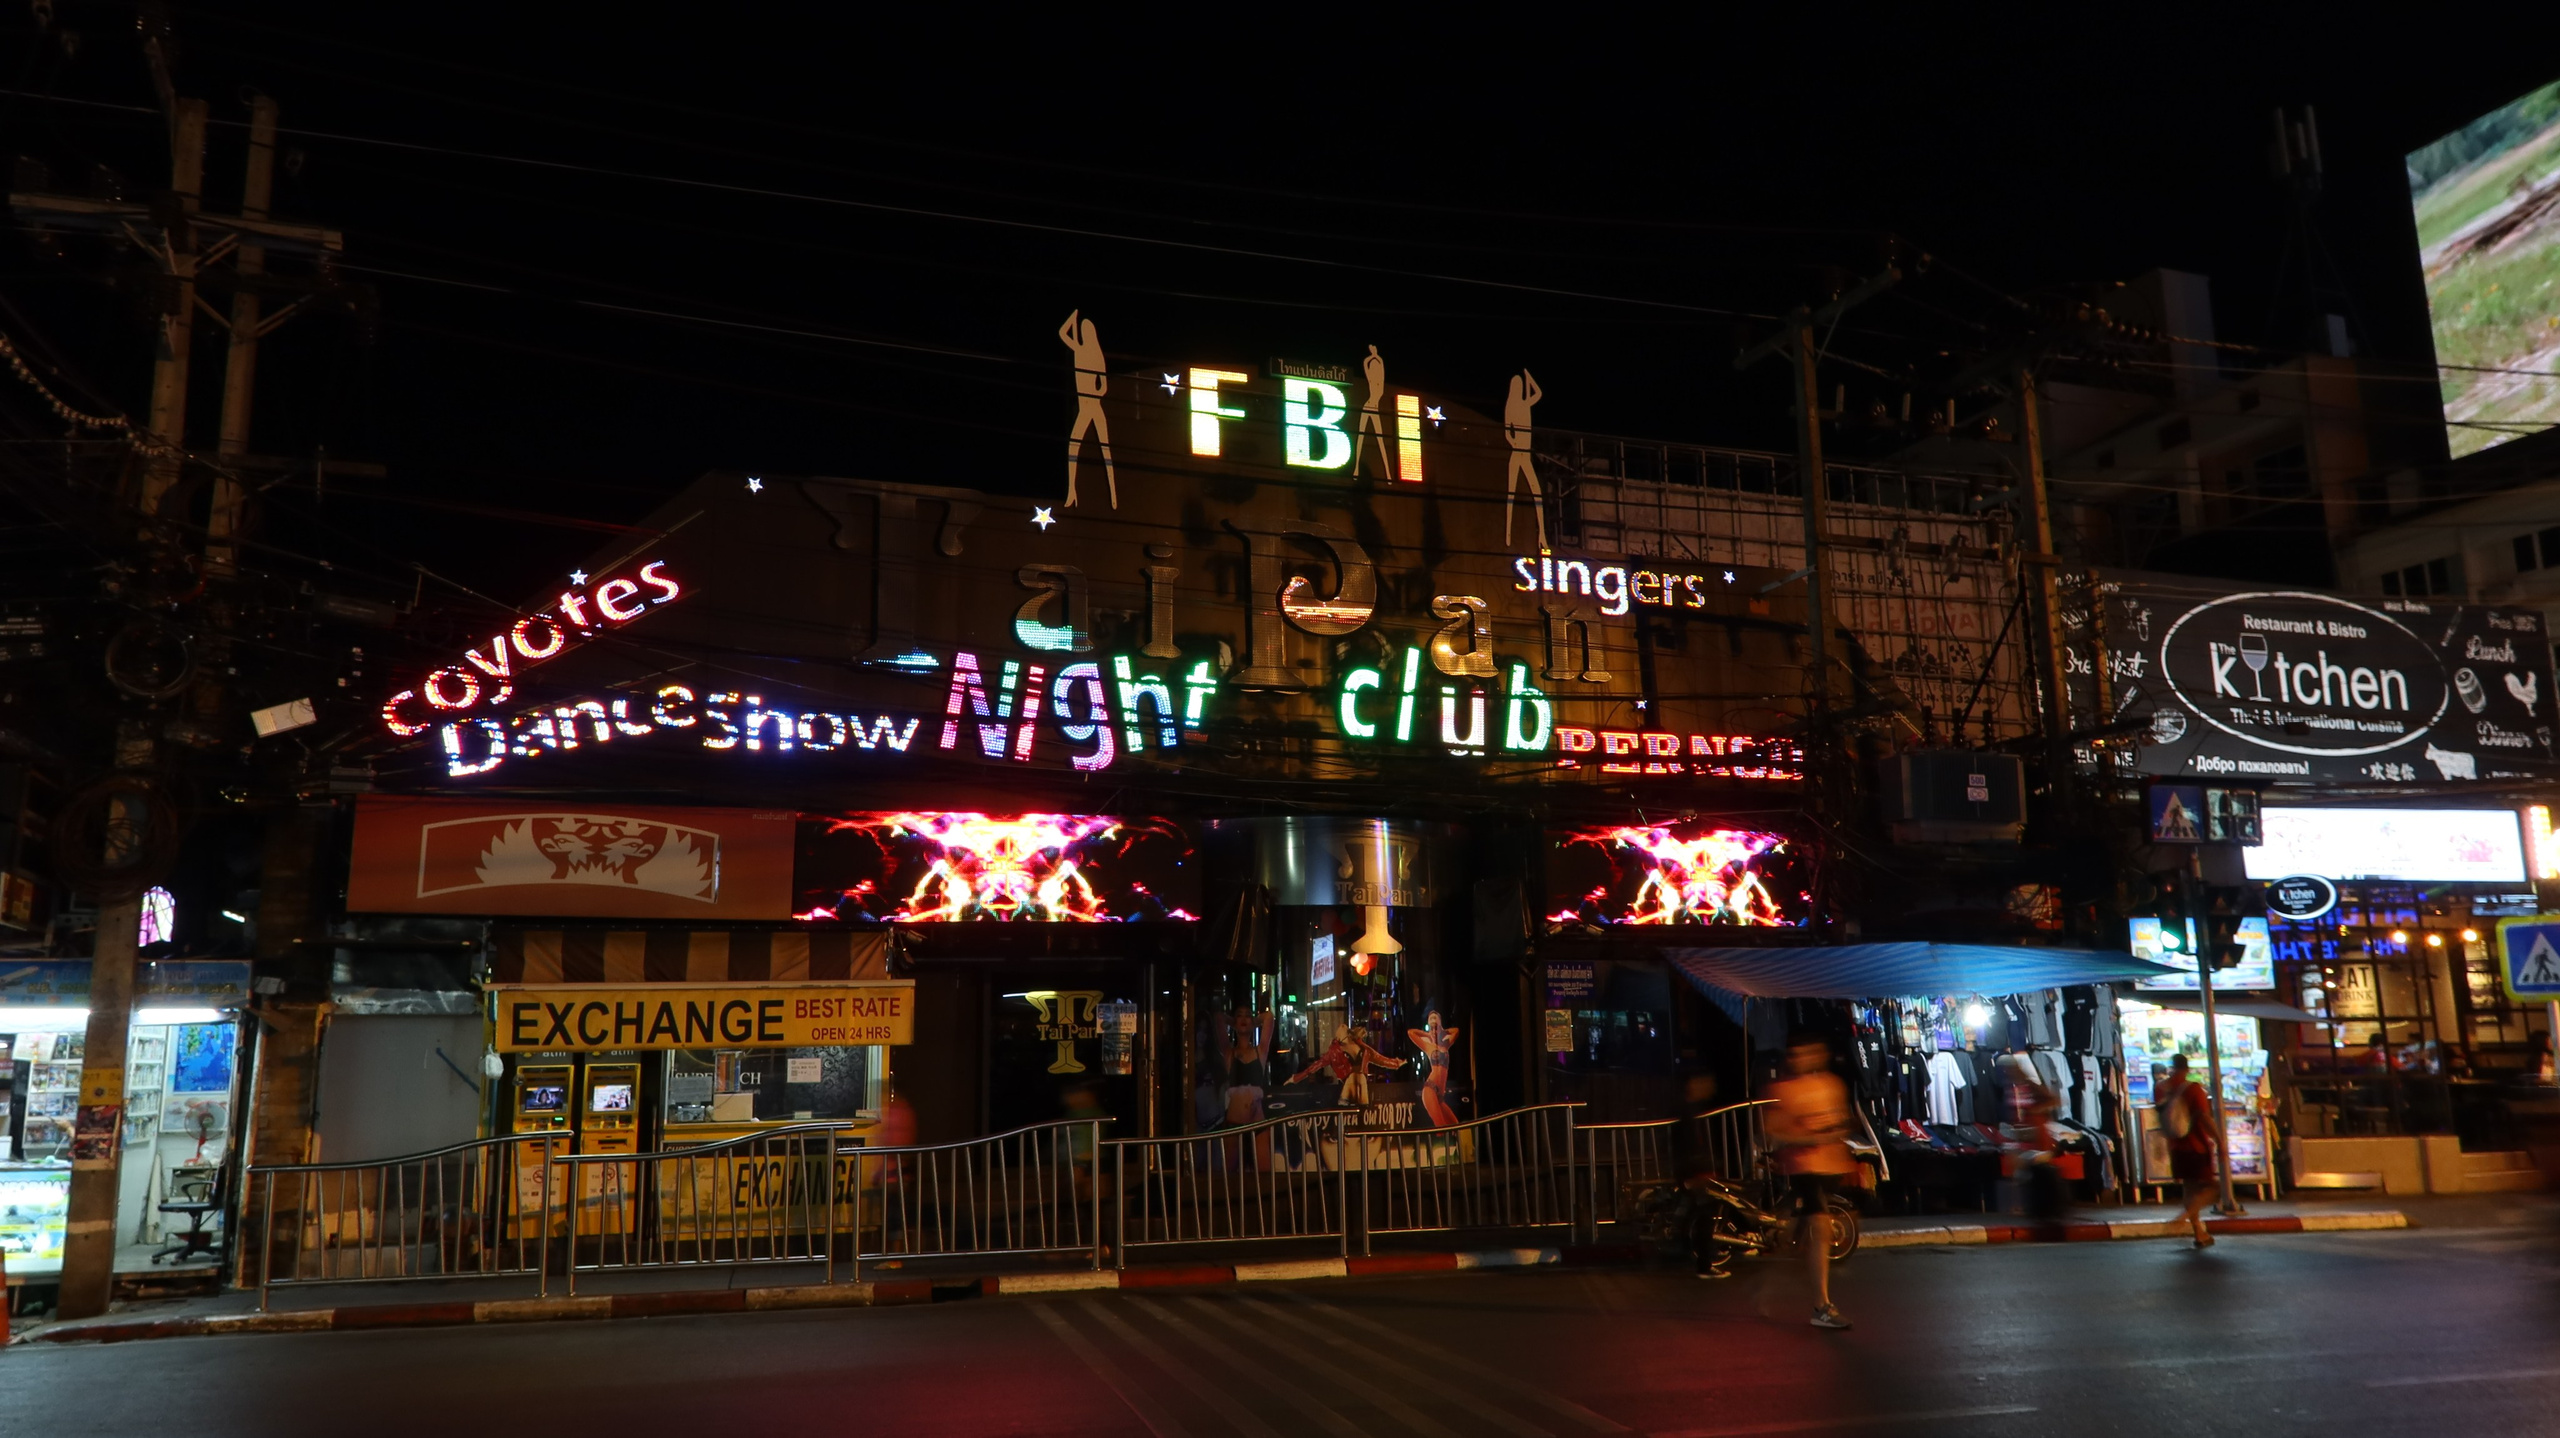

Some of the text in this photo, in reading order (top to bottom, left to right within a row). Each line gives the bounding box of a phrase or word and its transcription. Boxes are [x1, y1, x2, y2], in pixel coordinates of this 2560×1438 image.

[1189, 367, 1423, 482] FBI
[1514, 548, 1706, 616] singers
[2218, 642, 2237, 655] The
[2243, 613, 2367, 639] Restaurant & Bistro
[702, 685, 920, 751] show
[938, 651, 1217, 773] Night
[1338, 646, 1553, 757] club
[2196, 754, 2310, 776] Добро пожаловать!
[2339, 966, 2370, 989] AT
[511, 997, 901, 1046] EXCHANGE BEST RATE
[811, 1025, 891, 1041] OPEN 24 HRS
[735, 1157, 856, 1209] EXCHANGE
